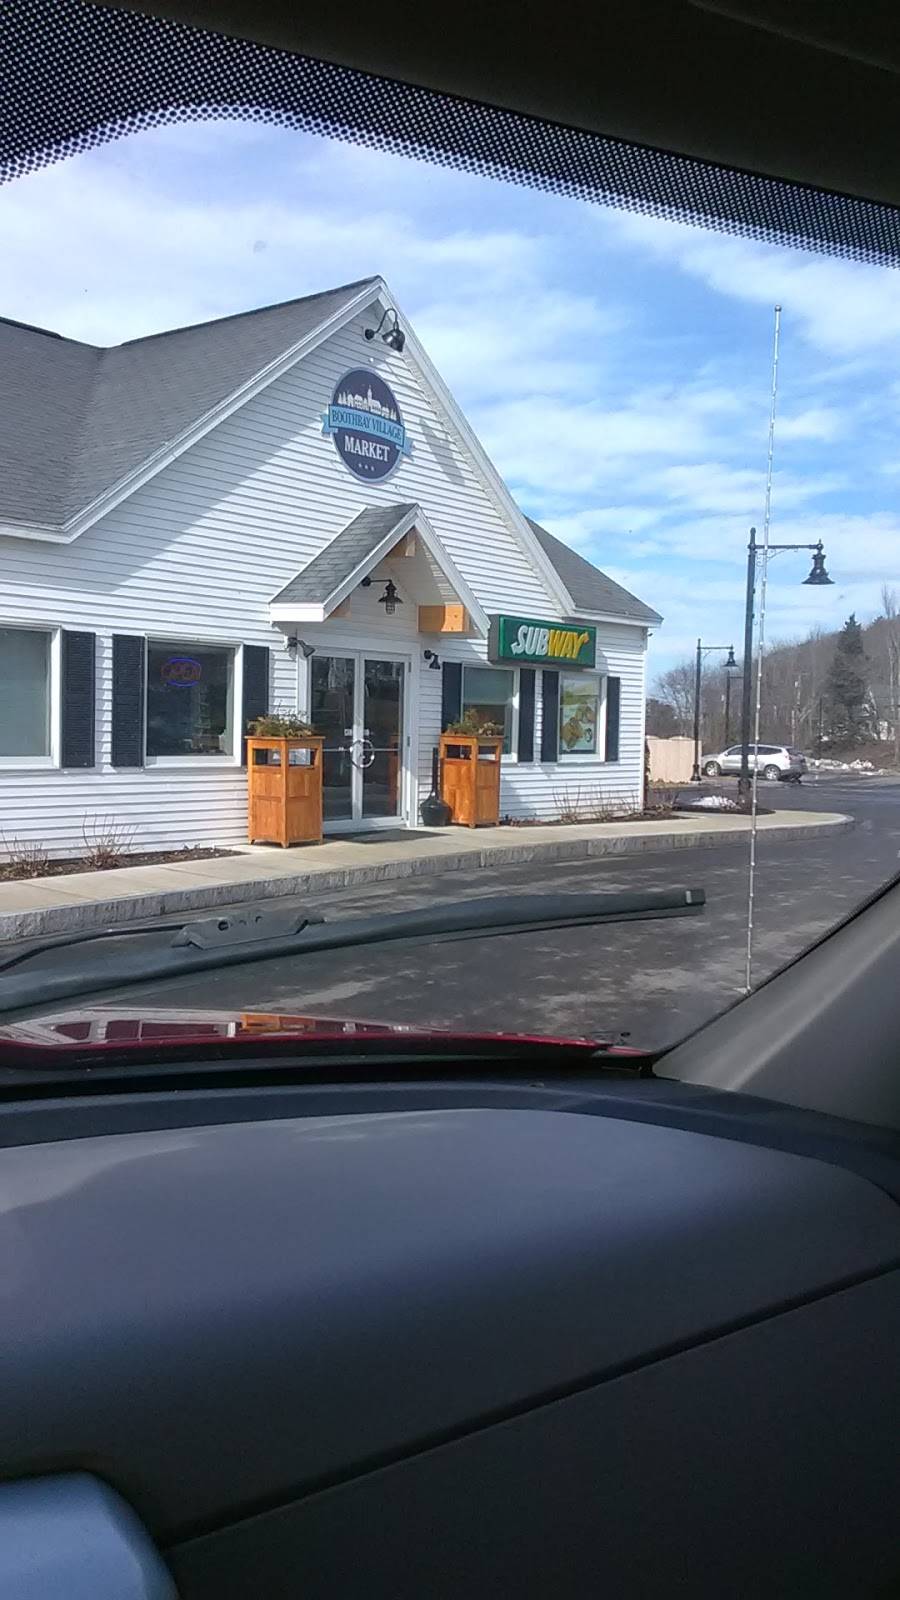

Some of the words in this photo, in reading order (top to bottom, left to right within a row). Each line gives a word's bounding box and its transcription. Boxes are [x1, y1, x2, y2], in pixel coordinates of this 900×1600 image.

[331, 410, 370, 429] BOOTHBAY
[371, 418, 402, 440] VILLAGE
[344, 435, 390, 462] MARKET
[510, 624, 590, 660] SUBWAY
